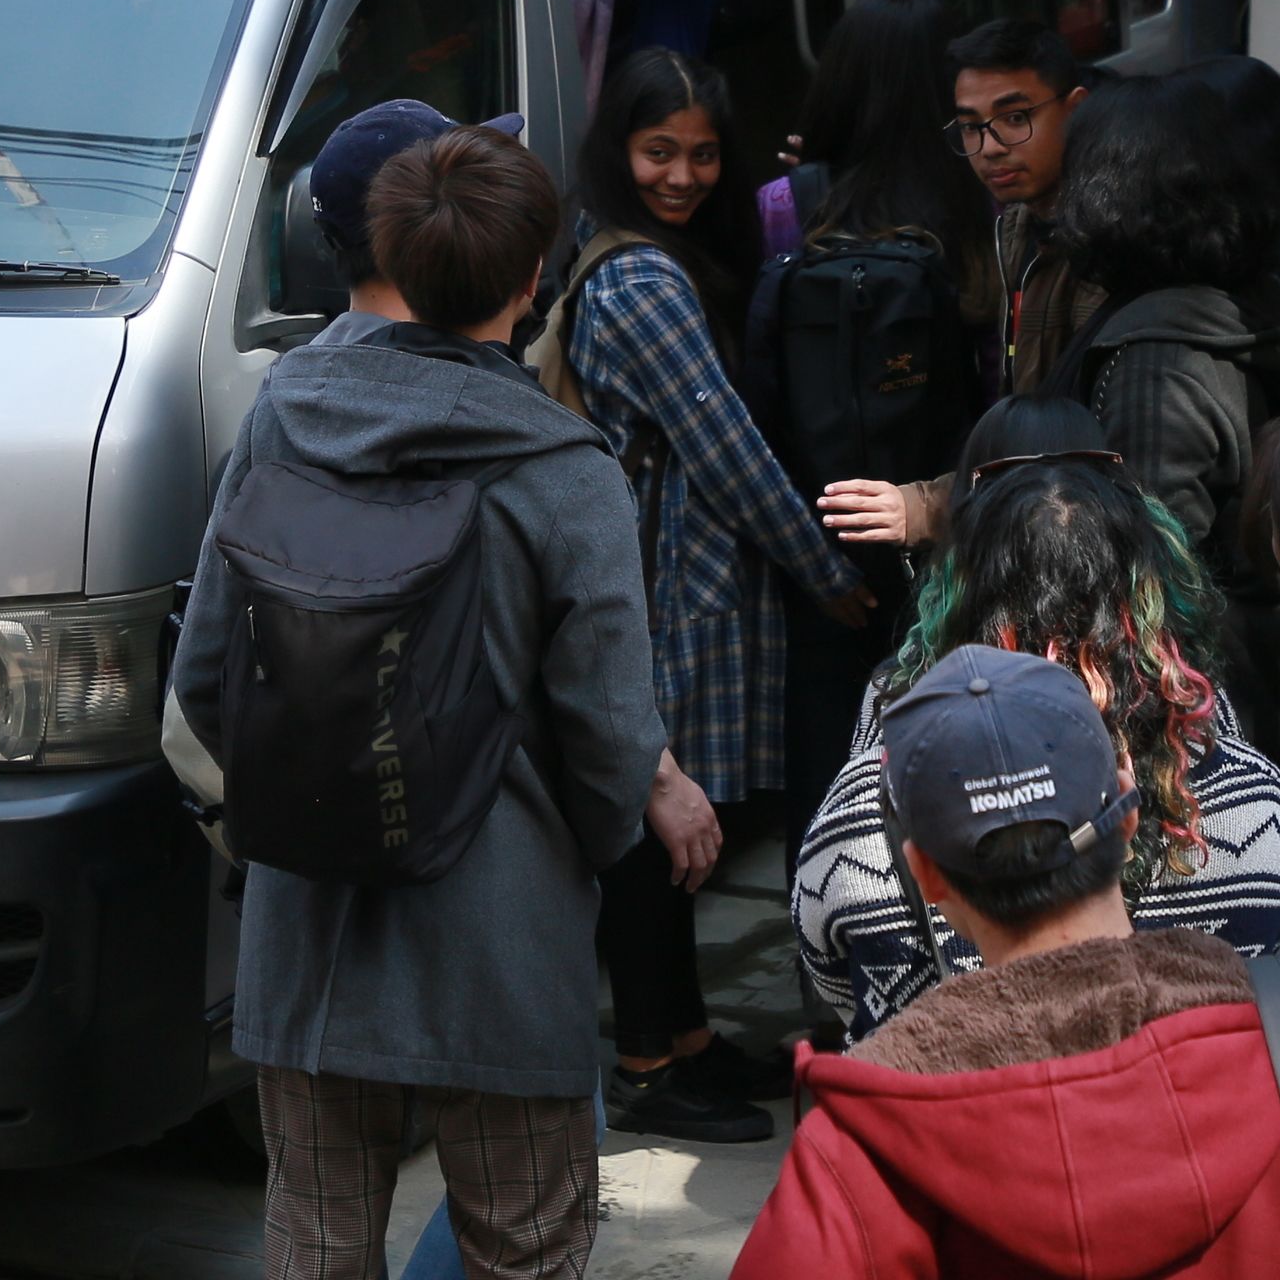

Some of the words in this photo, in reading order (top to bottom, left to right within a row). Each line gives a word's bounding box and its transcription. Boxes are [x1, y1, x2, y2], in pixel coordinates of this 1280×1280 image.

[963, 775, 998, 792] Global
[999, 763, 1050, 786] Teamwork
[969, 779, 1056, 814] KOMATSU
